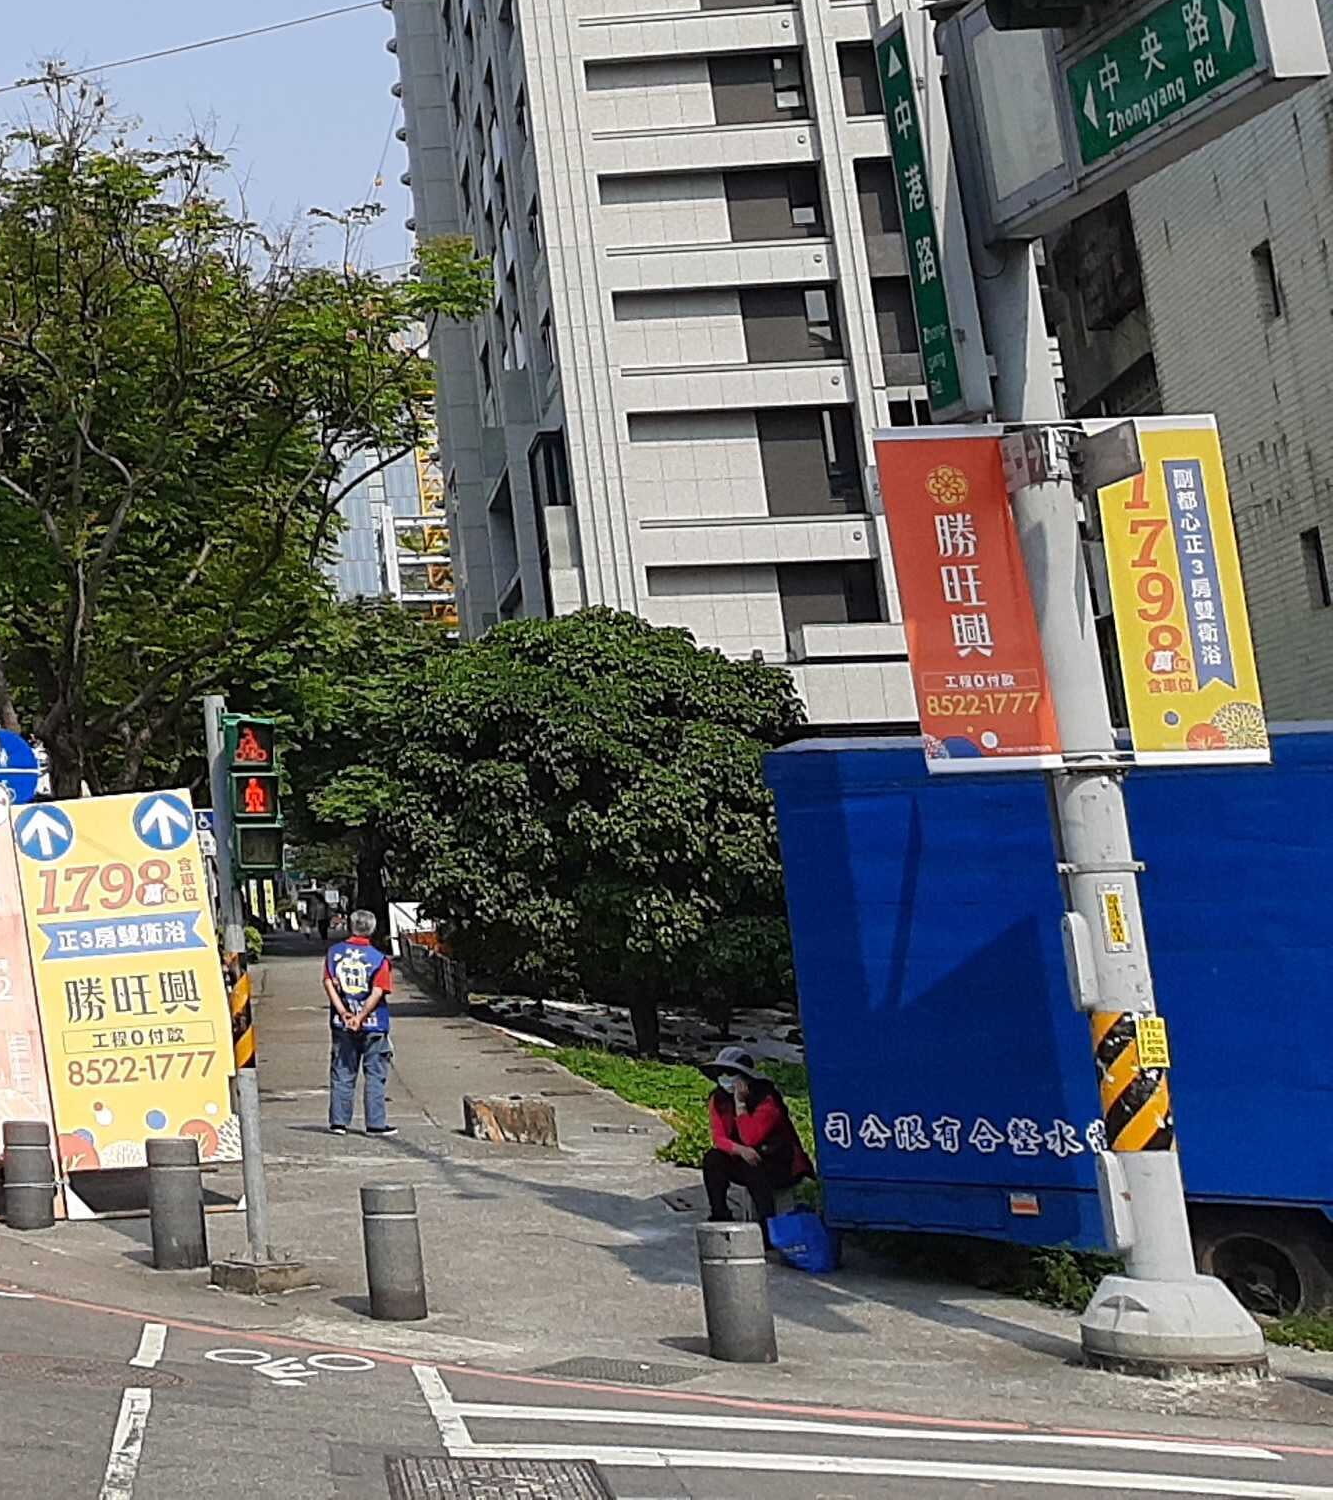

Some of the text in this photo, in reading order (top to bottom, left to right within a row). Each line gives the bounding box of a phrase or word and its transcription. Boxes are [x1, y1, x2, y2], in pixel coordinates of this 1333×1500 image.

[1106, 53, 1220, 138] Zhongyang Rd.
[894, 96, 937, 285] 中港路
[934, 512, 994, 657] 勝旺興
[926, 691, 1041, 716] 8522-1777
[65, 970, 201, 1023] 勝旺興
[68, 1050, 216, 1087] 8522-1777
